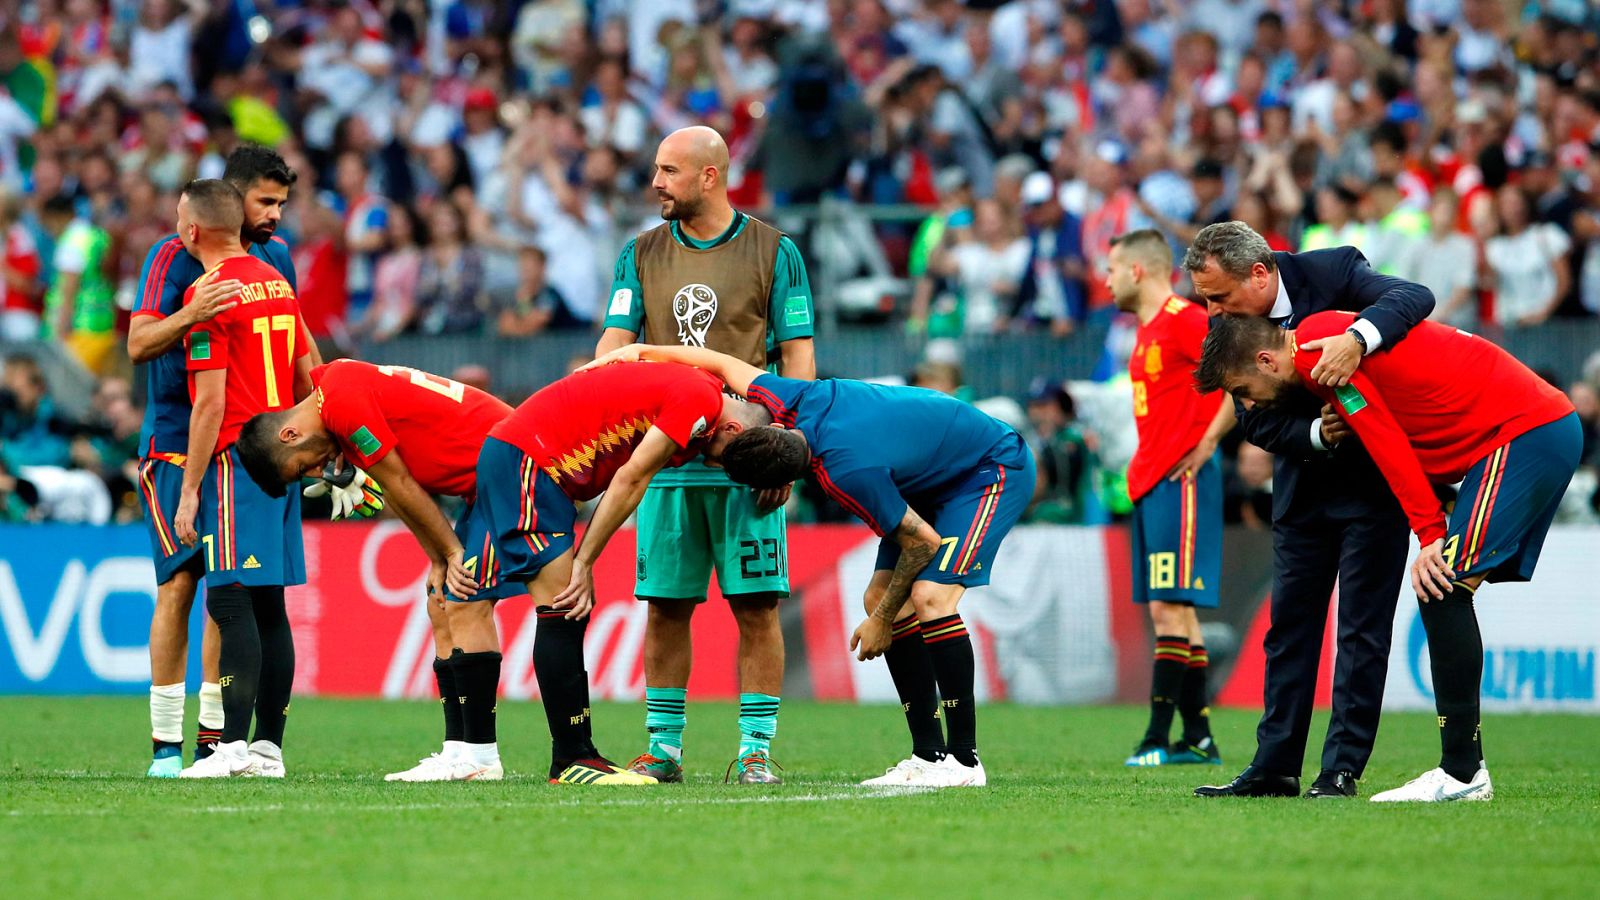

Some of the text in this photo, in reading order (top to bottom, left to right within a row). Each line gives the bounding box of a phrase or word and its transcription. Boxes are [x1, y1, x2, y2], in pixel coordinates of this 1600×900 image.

[252, 314, 296, 408] 17
[740, 538, 779, 579] 23
[939, 536, 960, 572] 7
[1148, 551, 1176, 590] 18
